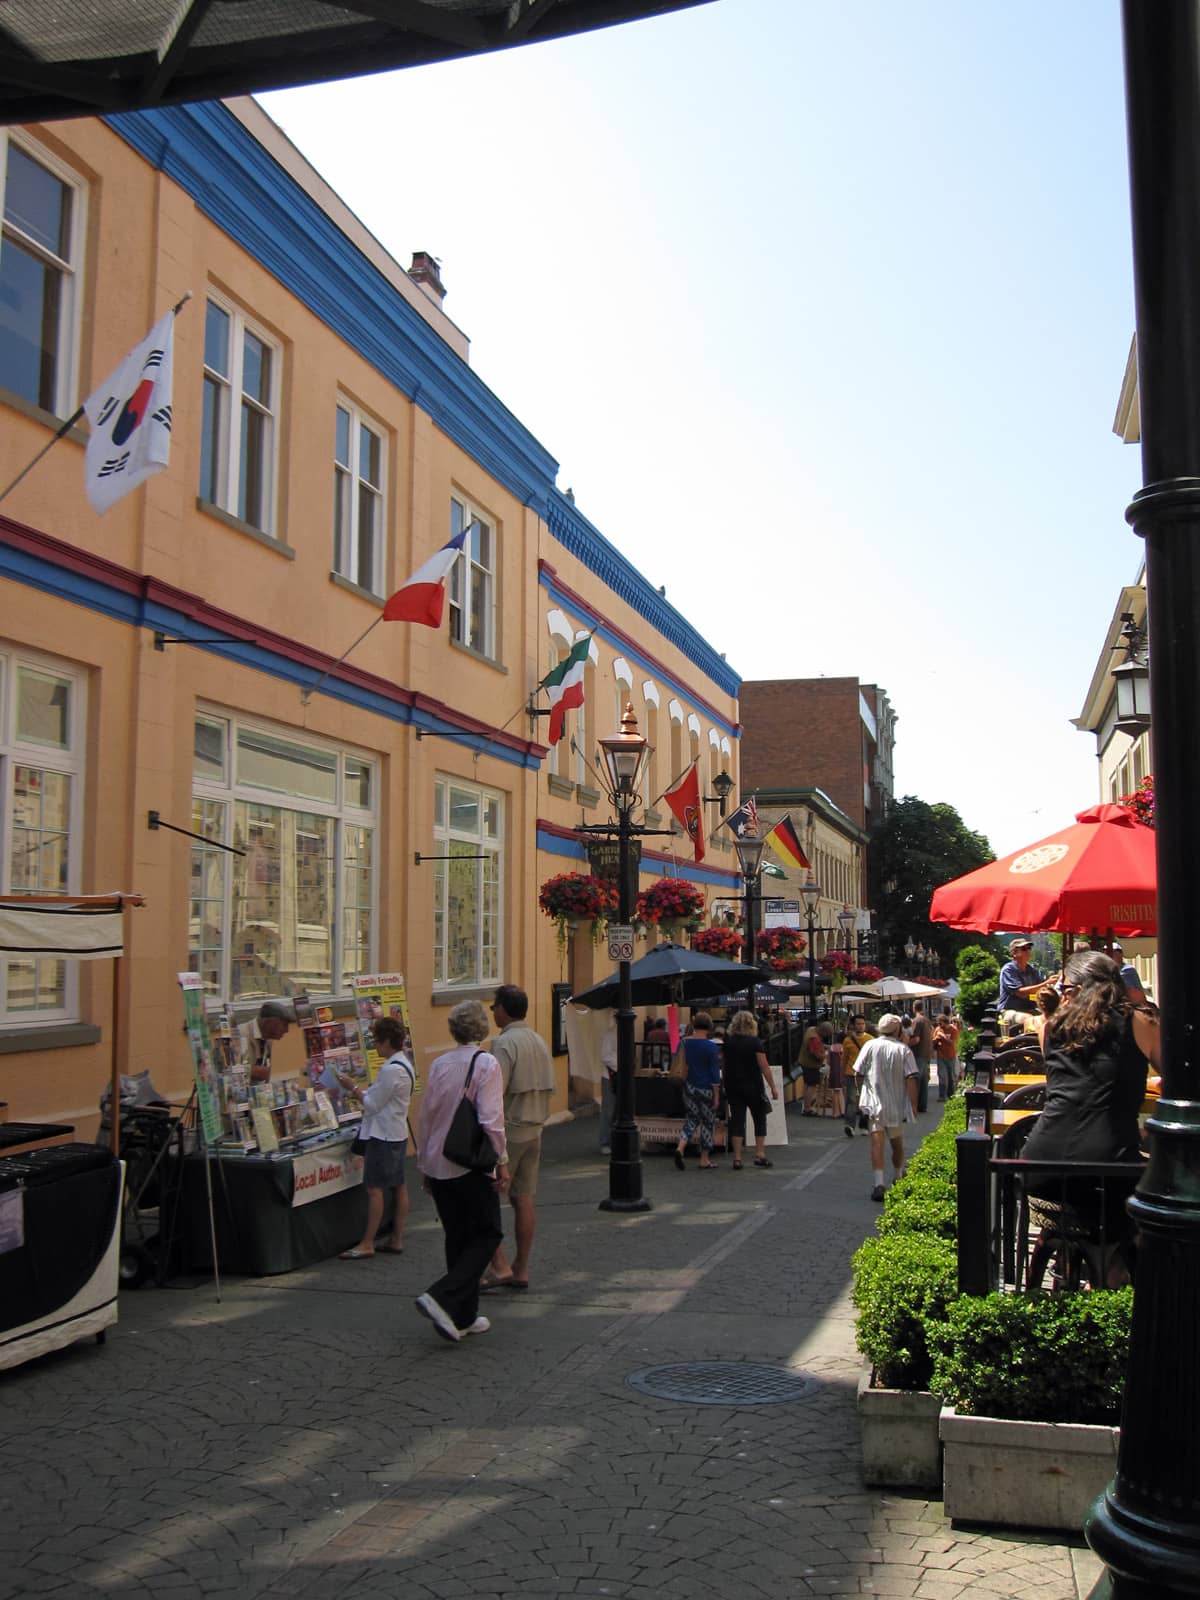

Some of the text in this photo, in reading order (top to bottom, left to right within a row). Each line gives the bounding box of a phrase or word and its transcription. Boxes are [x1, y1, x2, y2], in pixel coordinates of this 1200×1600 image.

[590, 846, 639, 855] GARRIS
[600, 855, 620, 864] HEA
[356, 975, 400, 987] Family Friendly
[295, 1168, 317, 1192] Local
